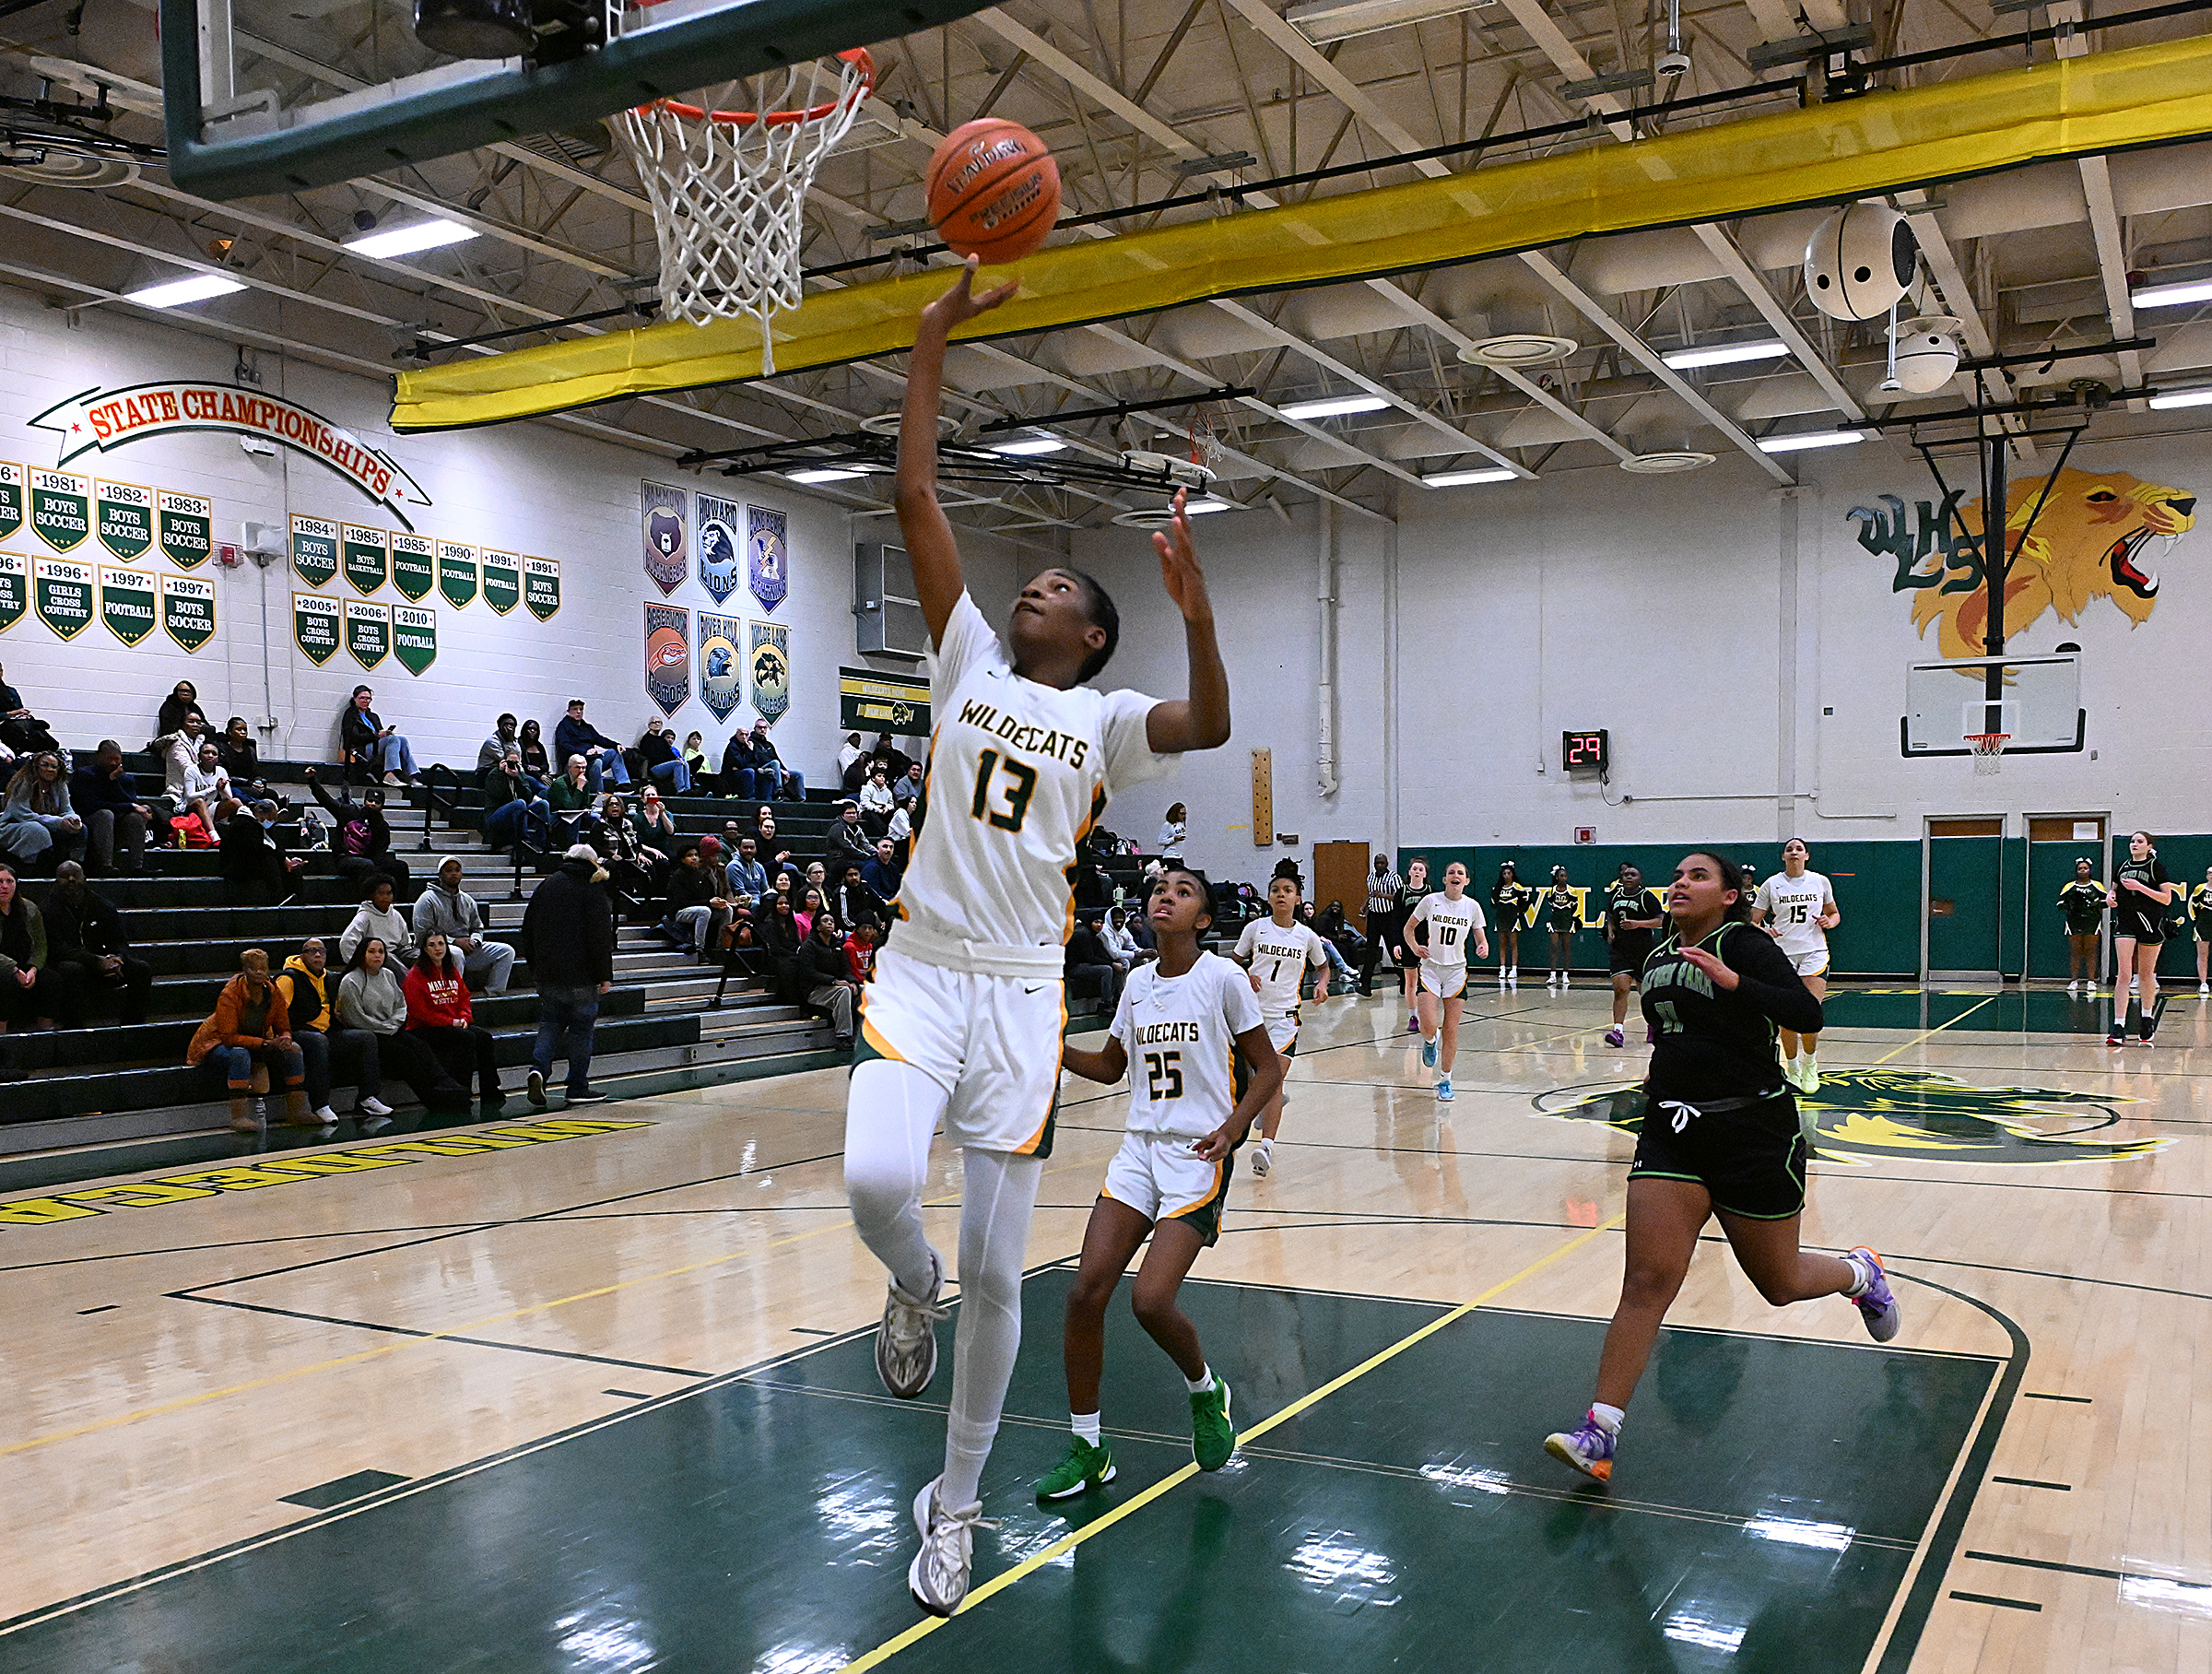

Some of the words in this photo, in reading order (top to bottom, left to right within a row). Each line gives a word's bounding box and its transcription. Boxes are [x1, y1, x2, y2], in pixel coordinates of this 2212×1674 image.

[88, 390, 180, 440] STATE
[182, 389, 393, 495] CHAMPIONSHIPS
[41, 475, 77, 492] 1981
[106, 485, 143, 503] 1982
[43, 498, 77, 514] BOYS
[167, 497, 203, 513] 1983
[36, 511, 87, 532] SOCCER
[108, 508, 141, 525] BOYS
[699, 495, 737, 535] HOWARD
[100, 522, 149, 541] SOCCER
[171, 518, 201, 535] BOYS
[299, 519, 330, 536] 1984
[163, 532, 208, 550] SOCCER
[350, 528, 379, 545] 1985
[301, 540, 328, 555] BOYS
[398, 537, 425, 553] 1985
[444, 546, 471, 560] 1990
[295, 553, 335, 571] SOCCER
[356, 553, 376, 565] BOYS
[489, 554, 512, 567] 1991
[47, 564, 82, 580] 1996
[348, 563, 384, 575] BASKETBALL
[394, 561, 431, 575] FOOTBALL
[441, 568, 476, 582] FOOTBALL
[531, 561, 553, 574] 1991
[112, 572, 145, 587] 1997
[485, 577, 517, 590] FOOTBALL
[700, 559, 738, 594] LIONS
[48, 584, 82, 598] GIRLS
[172, 582, 204, 595] 1997
[532, 581, 553, 593] BOYS
[50, 596, 82, 608] CROSS
[302, 599, 332, 612] 2005
[527, 592, 558, 606] SOCCER
[43, 606, 88, 619] COUNTRY
[104, 601, 154, 619] FOOTBALL
[175, 601, 205, 617] BOYS
[354, 607, 382, 619] 2006
[168, 615, 212, 631] SOCCER
[306, 617, 329, 628] BOYS
[402, 610, 428, 625] 2010
[646, 607, 688, 644] RESERVOIR
[306, 627, 330, 637] CROSS
[358, 624, 379, 636] BOYS
[301, 634, 335, 646] COUNTRY
[357, 634, 380, 644] CROSS
[396, 633, 434, 649] FOOTBALL
[352, 642, 385, 653] COUNTRY
[648, 670, 689, 702] GATORS
[701, 677, 741, 710] HAWKS
[958, 698, 1088, 770] WILDECATS
[1570, 737, 1601, 764] 29
[970, 747, 1040, 835] 13
[1779, 893, 1818, 904] WILDECATS
[1431, 914, 1468, 927] WILDECATS
[1790, 904, 1807, 924] 15
[1439, 925, 1457, 946] 10
[1257, 943, 1302, 960] WILDECATS
[1269, 960, 1281, 982] 1
[1144, 1050, 1184, 1102] 25
[0, 1118, 658, 1228] WILDECA
